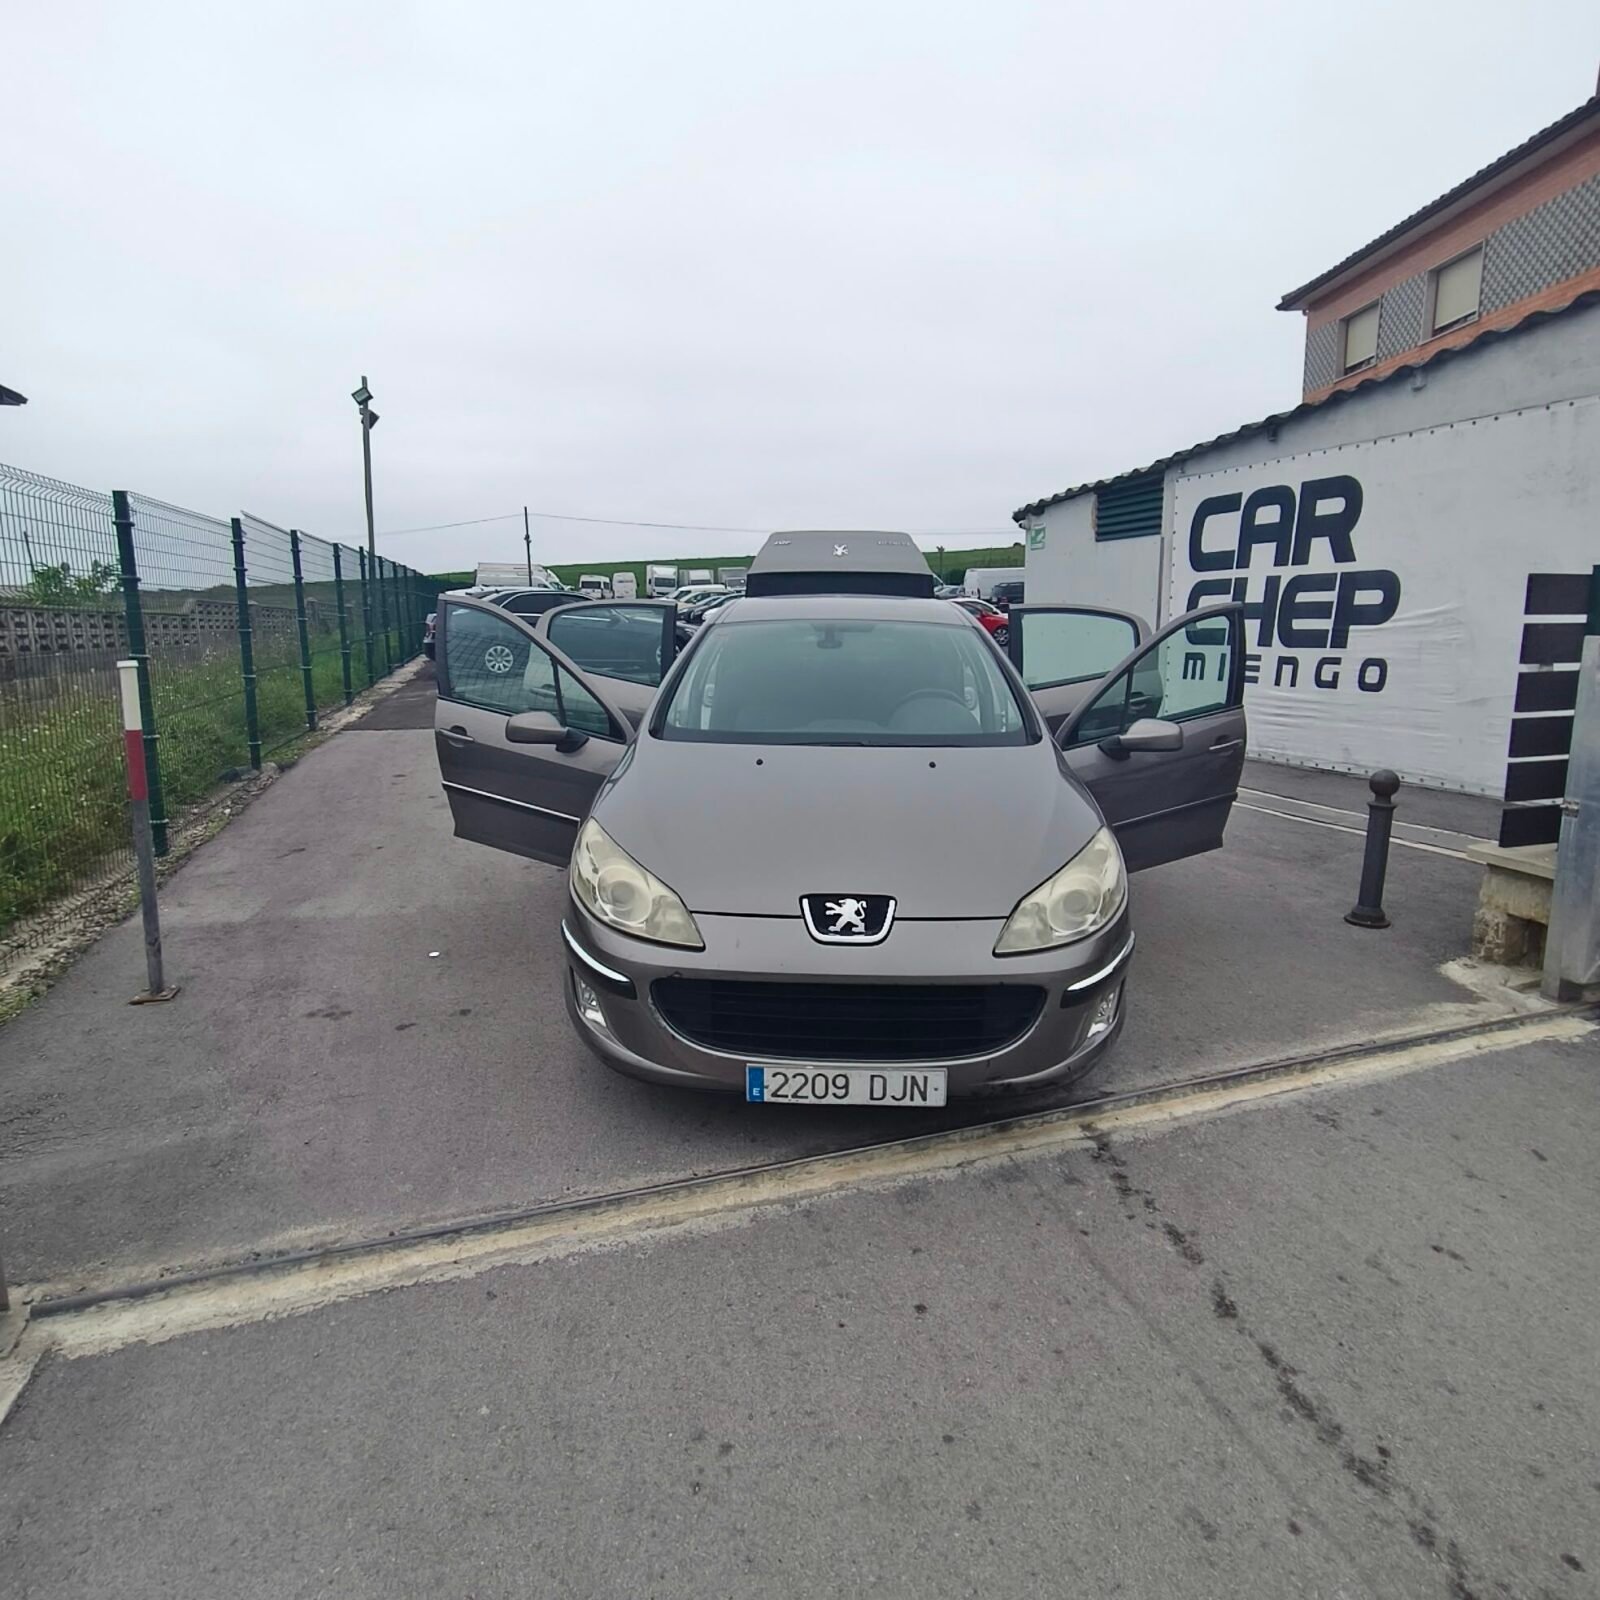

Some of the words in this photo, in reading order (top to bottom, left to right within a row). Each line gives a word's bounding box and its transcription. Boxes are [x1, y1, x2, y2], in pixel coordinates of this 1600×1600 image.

[1189, 475, 1363, 572] CAR
[1185, 569, 1401, 648] CHEP
[752, 1087, 761, 1096] E
[771, 1072, 850, 1100] 2209
[869, 1074, 928, 1102] DJN
